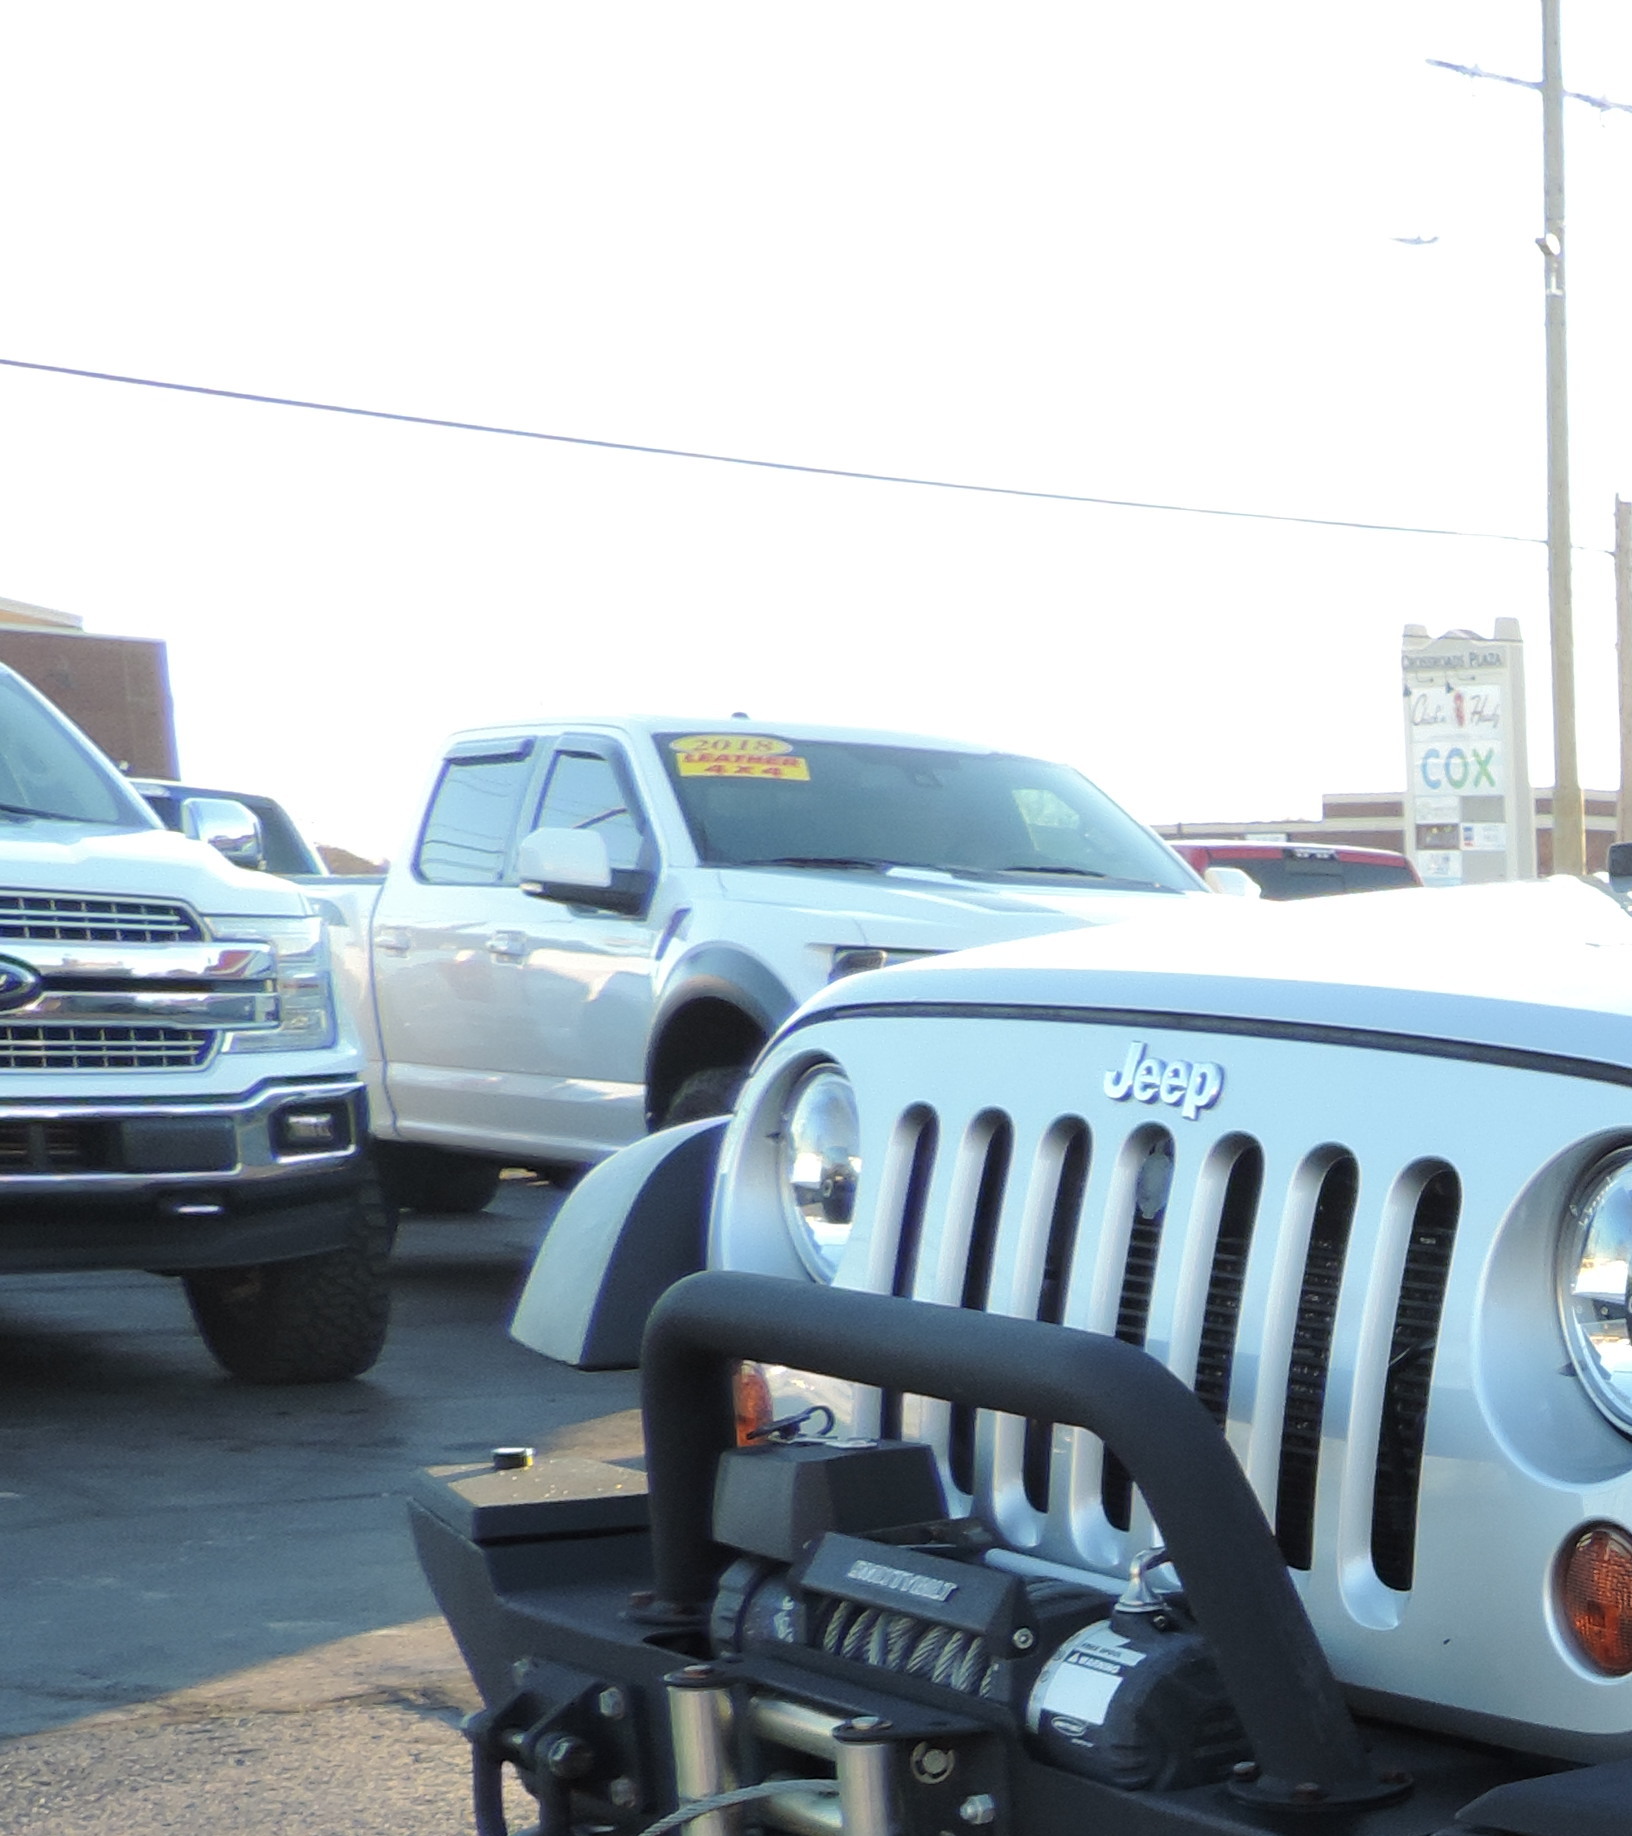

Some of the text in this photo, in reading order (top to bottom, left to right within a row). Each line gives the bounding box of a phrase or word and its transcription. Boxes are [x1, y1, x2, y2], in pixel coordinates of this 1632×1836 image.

[1468, 651, 1501, 668] PLAZA
[693, 739, 774, 751] 2018
[683, 753, 799, 766] LEATHER
[1420, 747, 1496, 789] COX
[1103, 1040, 1226, 1122] Jeep
